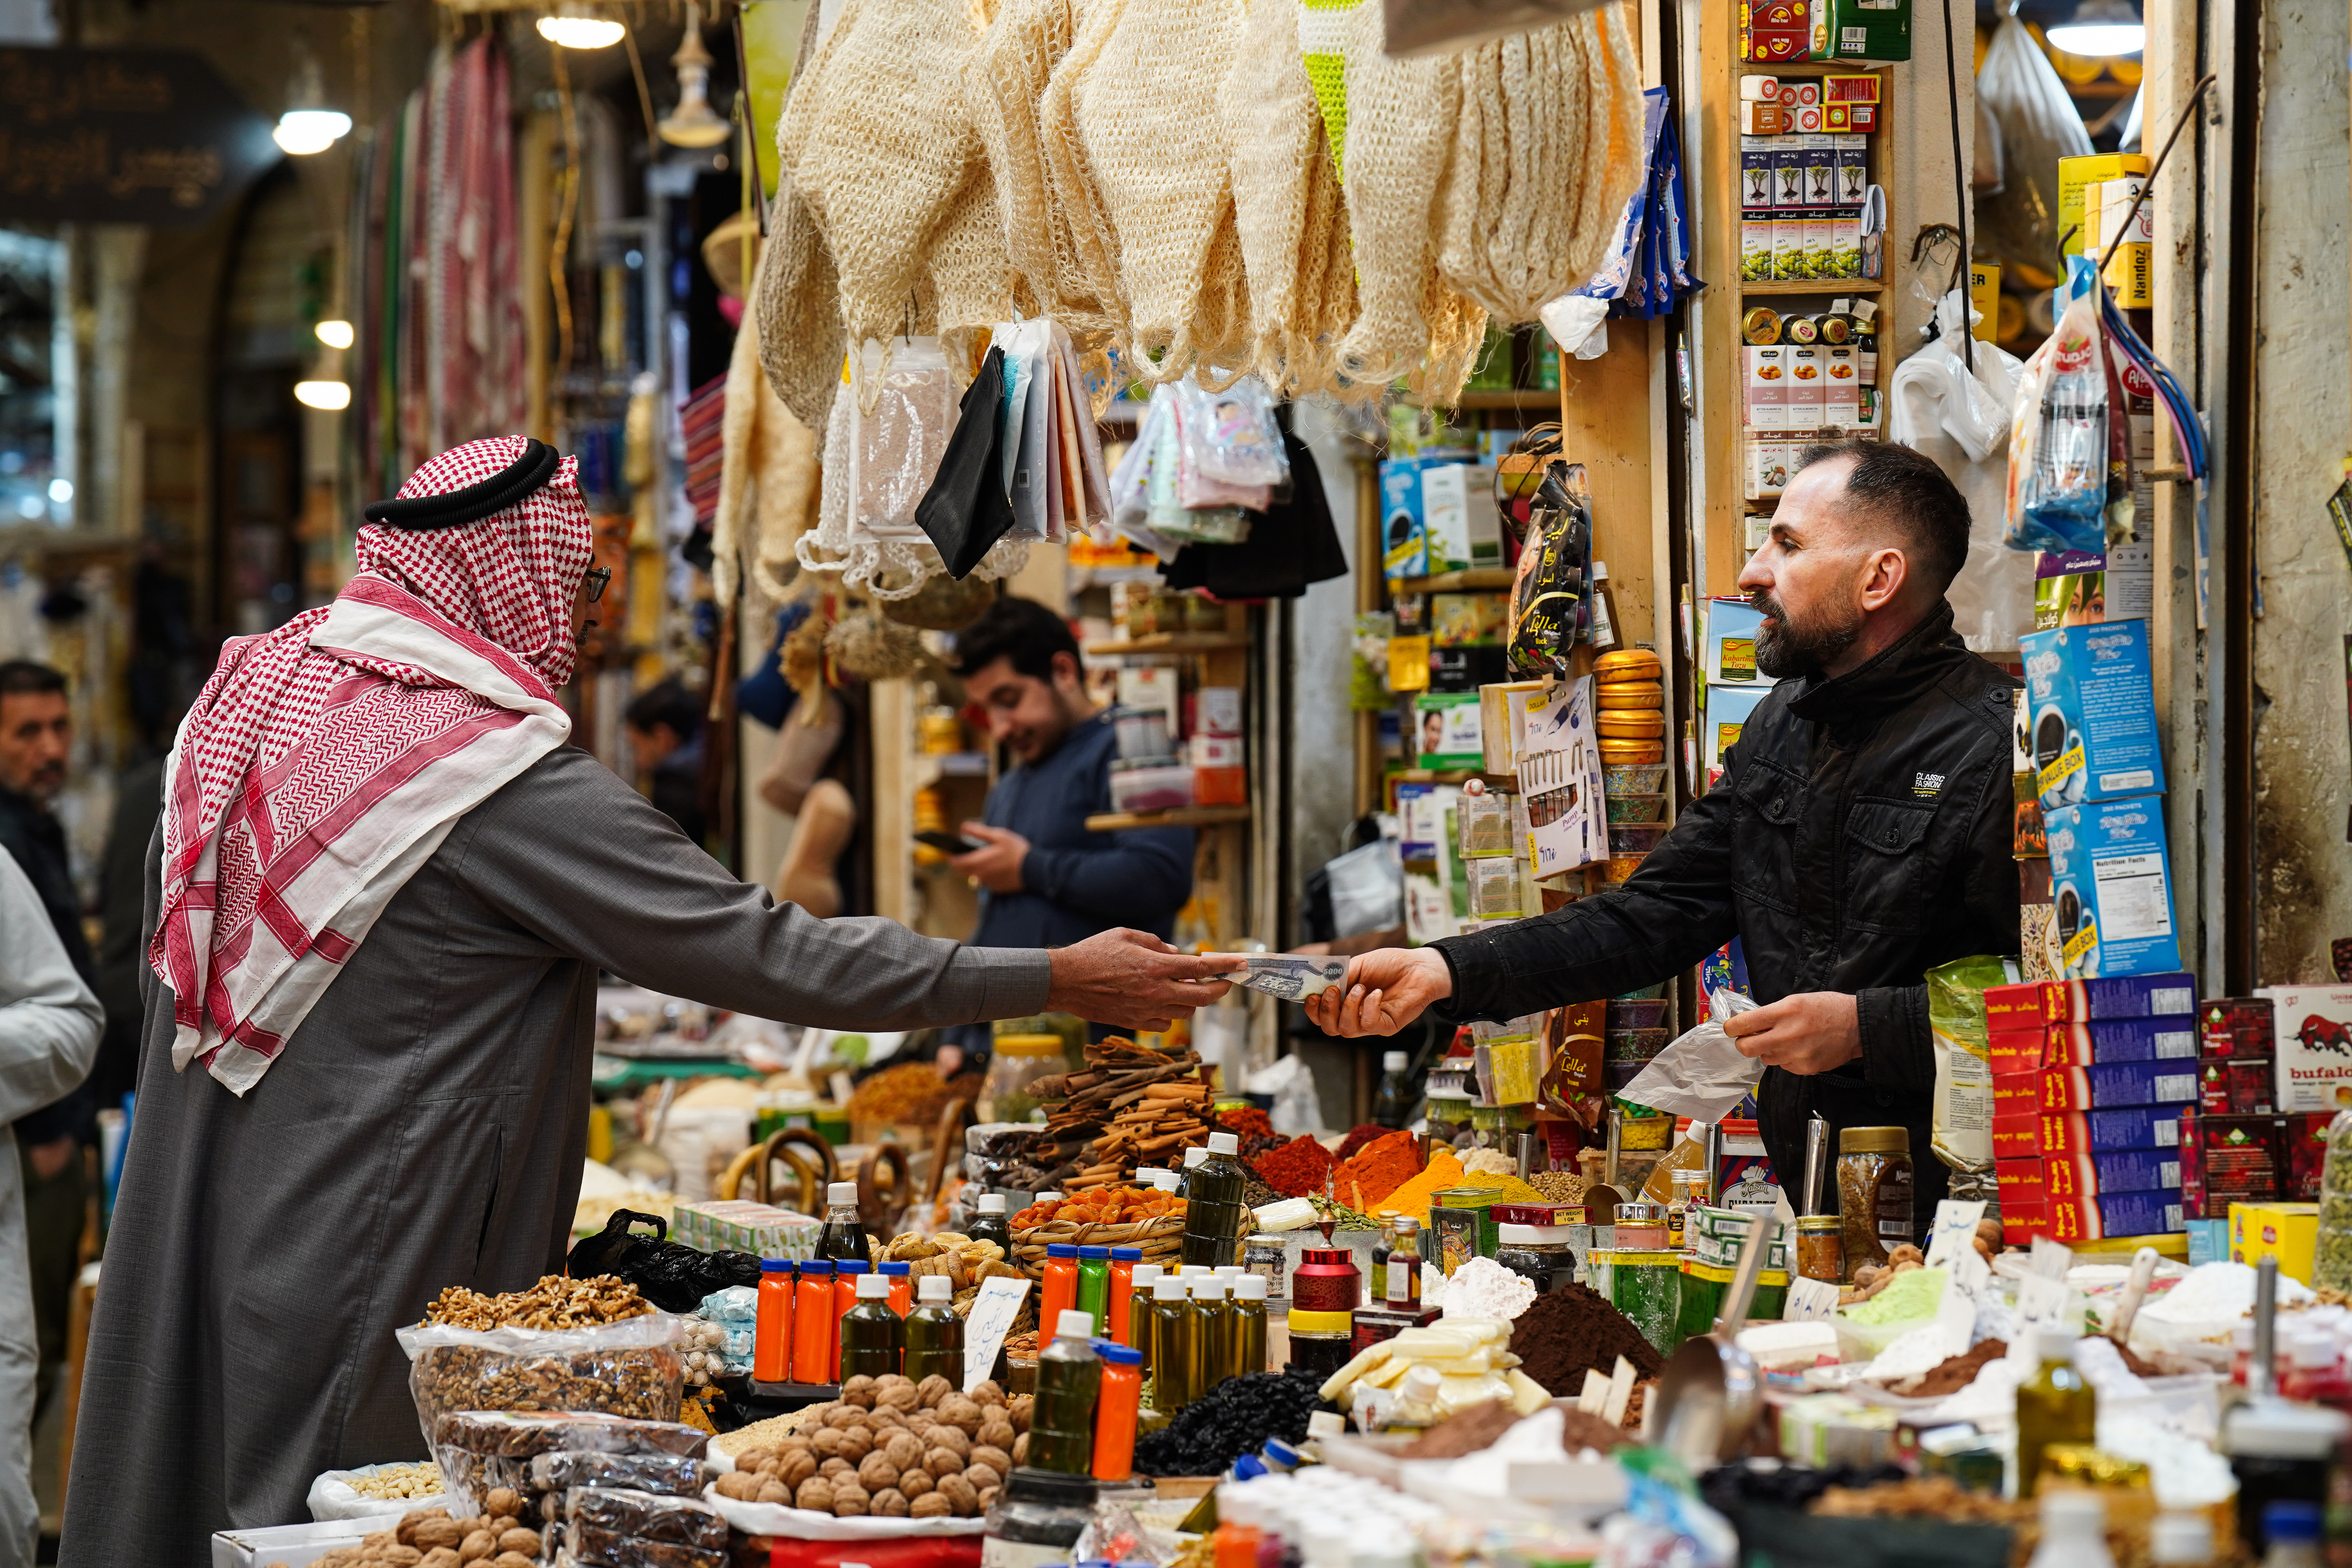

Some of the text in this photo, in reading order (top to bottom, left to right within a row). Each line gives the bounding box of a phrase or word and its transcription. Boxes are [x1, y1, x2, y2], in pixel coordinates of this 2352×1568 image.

[1972, 274, 1985, 285] ER
[2133, 250, 2146, 299] Nandoz
[1529, 700, 1546, 710] DOLLAR
[2064, 751, 2083, 770] BOX
[1915, 780, 1942, 788] FASHION
[1916, 772, 1945, 782] CLASSIC
[1562, 810, 1578, 827] Pump
[2080, 931, 2095, 948] BOX
[1323, 967, 1343, 975] 5000
[1574, 1013, 1589, 1027] بني
[1561, 1056, 1584, 1072] Lella
[2041, 1116, 2053, 1151] Custard
[2054, 1116, 2065, 1150] Powder
